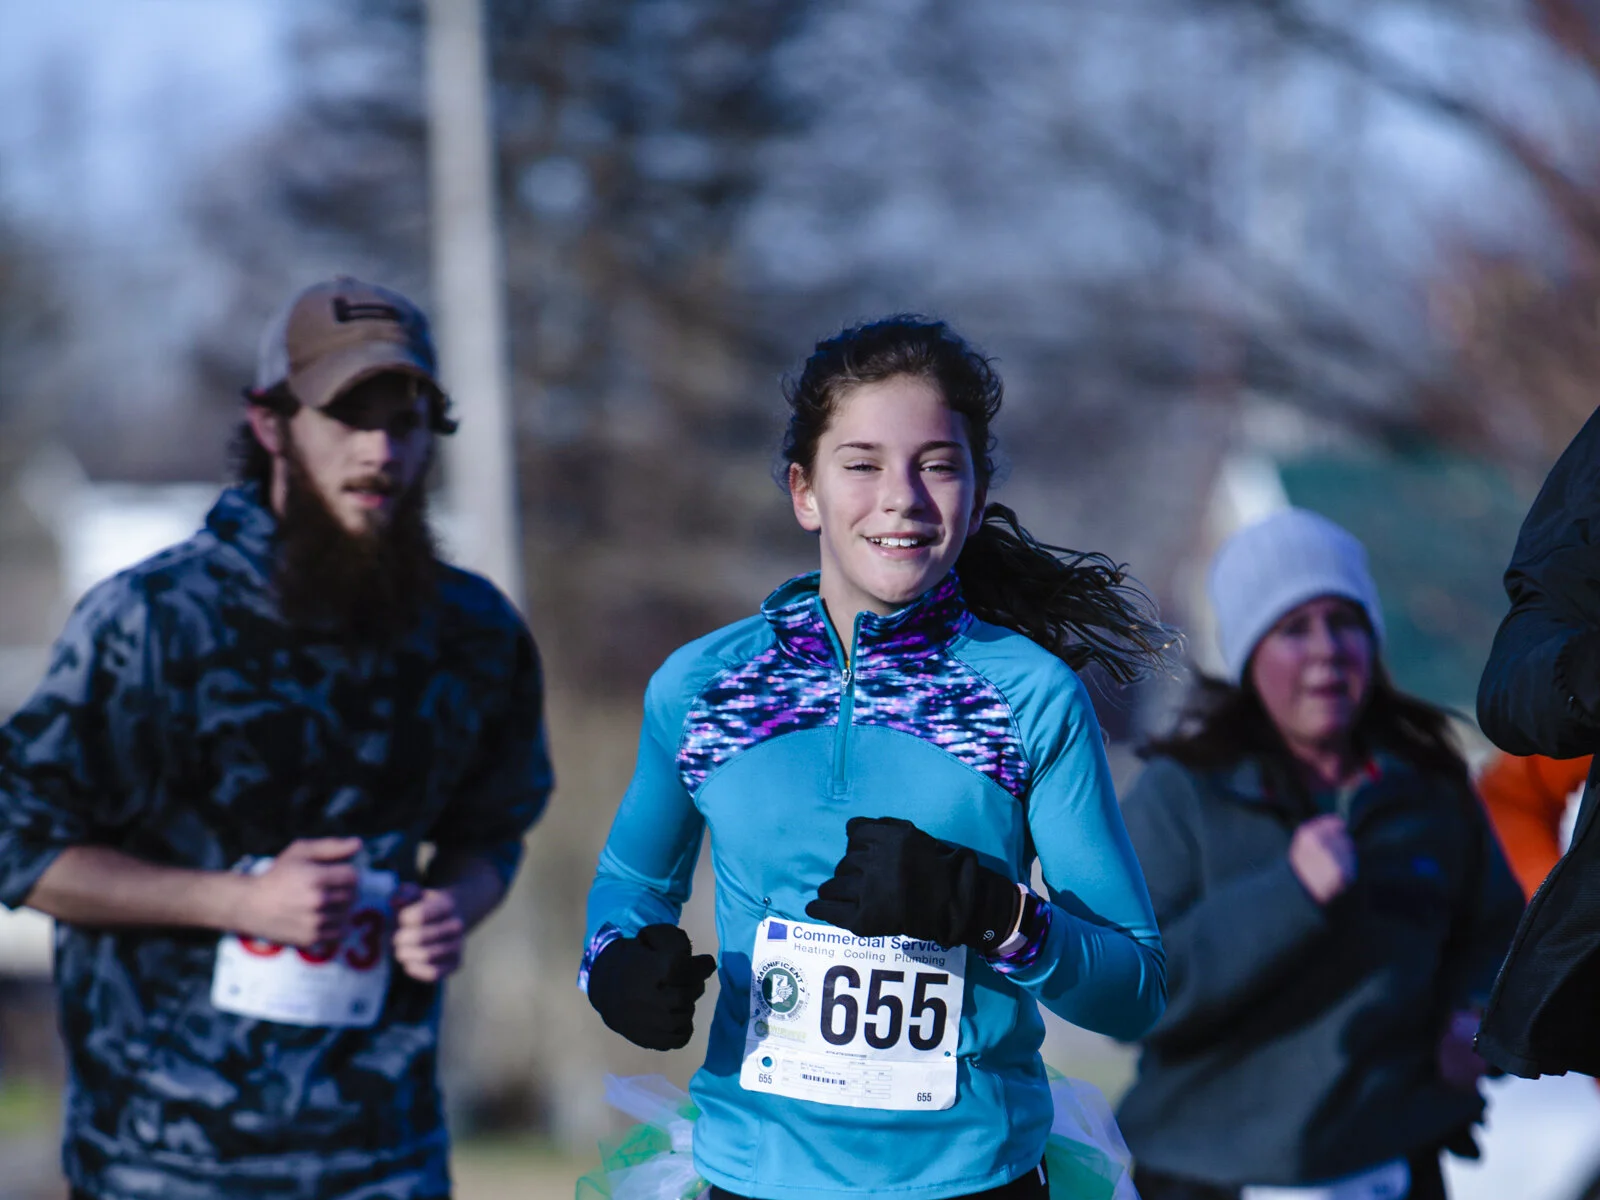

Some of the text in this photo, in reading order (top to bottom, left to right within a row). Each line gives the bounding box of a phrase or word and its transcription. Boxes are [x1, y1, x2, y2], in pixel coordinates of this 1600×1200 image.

[793, 926, 885, 948] Commercial
[793, 943, 946, 966] Heating Cooling Plumbing
[756, 960, 804, 985] MAGNIFICENT
[820, 964, 949, 1051] 655
[758, 1073, 773, 1085] 655
[916, 1092, 932, 1102] 655
